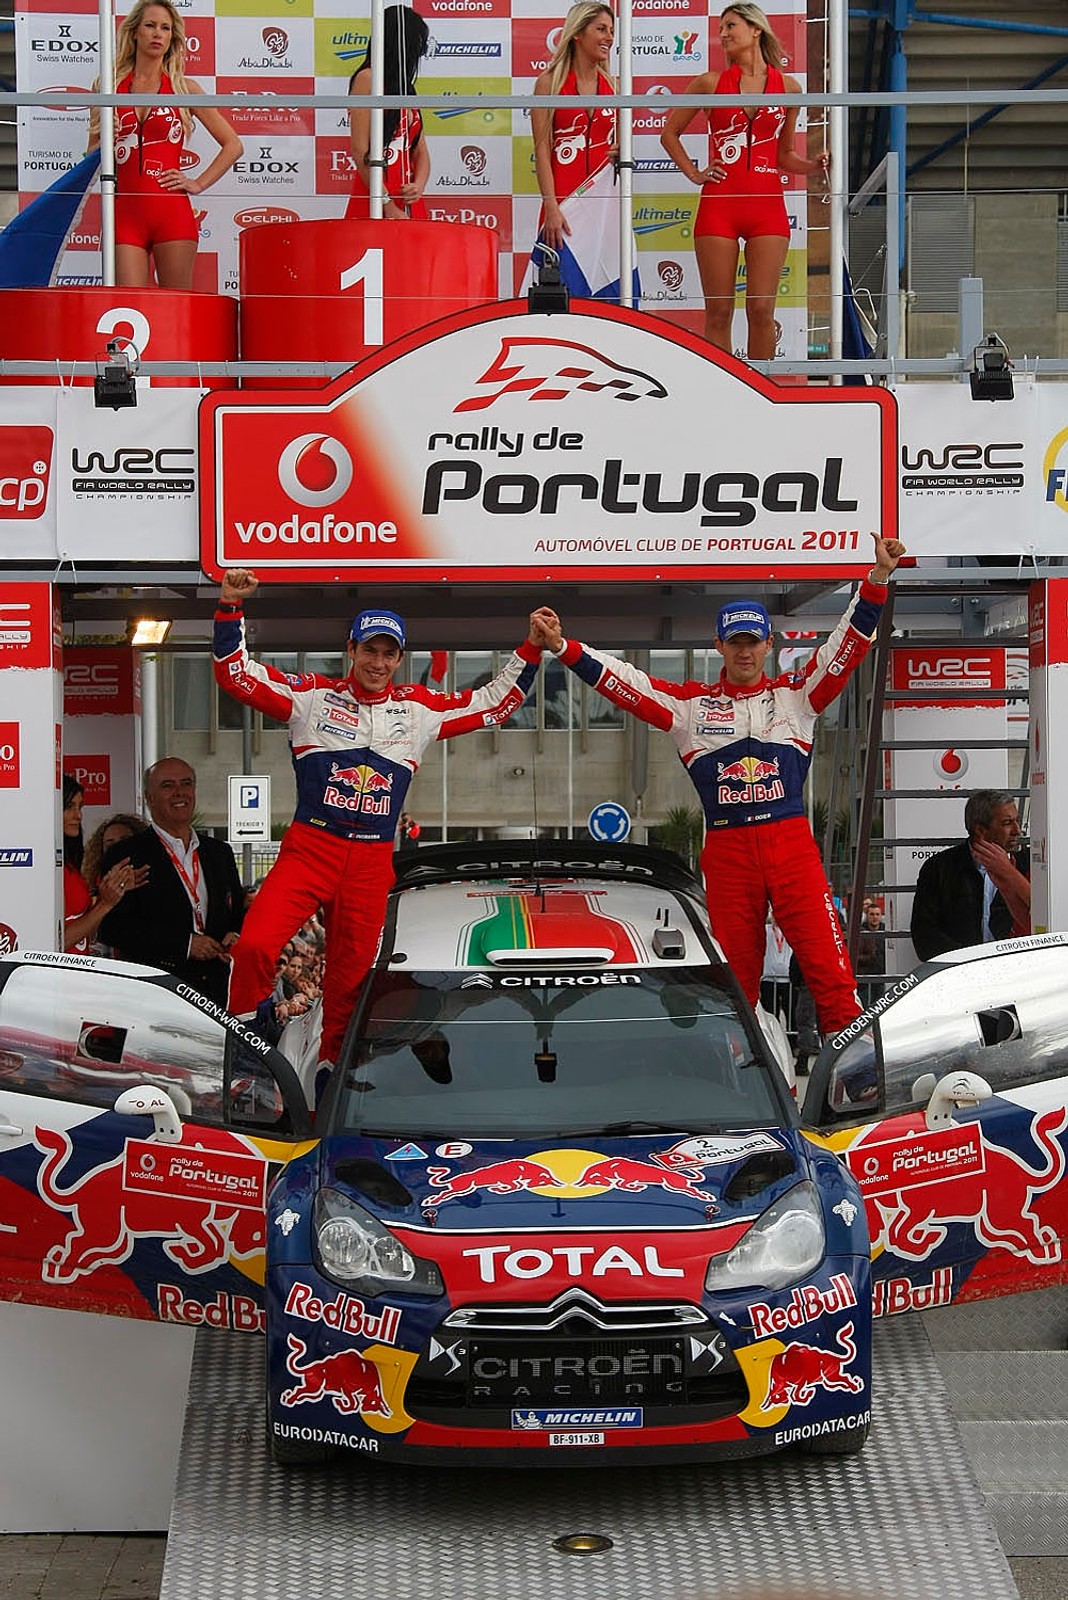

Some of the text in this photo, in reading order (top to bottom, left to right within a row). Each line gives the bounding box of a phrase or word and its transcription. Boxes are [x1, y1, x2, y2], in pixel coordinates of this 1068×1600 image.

[432, 0, 492, 11] vodafone
[31, 40, 99, 52] EDOX
[332, 33, 368, 45] ultim
[36, 54, 94, 63] Swiss Watches
[439, 45, 499, 54] MICHELIN
[616, 46, 671, 55] PRTUGAL
[632, 116, 666, 127] vodaf
[233, 162, 299, 173] EDOX
[238, 176, 294, 184] Swiss Watches
[242, 215, 292, 223] DELPHI
[340, 248, 384, 346] 1
[428, 426, 583, 458] rally de
[72, 448, 194, 473] WRC
[902, 443, 1024, 470] WRC
[147, 482, 192, 490] RALLY
[421, 457, 858, 527] Portugal
[235, 514, 397, 543] vodafone
[534, 531, 859, 552] AUTOMÓVEL CLUB DE PORTUGAL 2011
[908, 658, 991, 676] WRC
[332, 711, 358, 725] TOTAL
[242, 788, 257, 806] P
[324, 786, 390, 814] Red Bull
[719, 780, 784, 804] Red Bull
[456, 860, 654, 875] CITROËN
[1030, 934, 1065, 946] FINANCE
[60, 956, 96, 967] FINANCE
[500, 972, 642, 986] CITROËN
[176, 983, 271, 1055] CITROEN-WRC.COM
[832, 973, 919, 1050] CITROEN-WRC.COM
[444, 1145, 464, 1155] E
[697, 1140, 713, 1148] 2
[893, 1141, 977, 1172] Portugal
[130, 1171, 164, 1181] vodafone
[169, 1164, 259, 1190] Portugal
[462, 1245, 685, 1284] TOTAL
[887, 1267, 953, 1314] Bull
[157, 1283, 229, 1329] Red
[284, 1281, 347, 1330] Red
[341, 1297, 402, 1345] Bull
[747, 1287, 803, 1340] Red
[799, 1271, 857, 1324] Bull
[473, 1348, 683, 1379] CITROËN
[474, 1383, 683, 1397] RACING
[544, 1412, 636, 1424] MICHELIN
[273, 1421, 380, 1453] EURODATACAR
[774, 1410, 871, 1446] EURODATACAR
[553, 1433, 600, 1445] BF-911-XB
